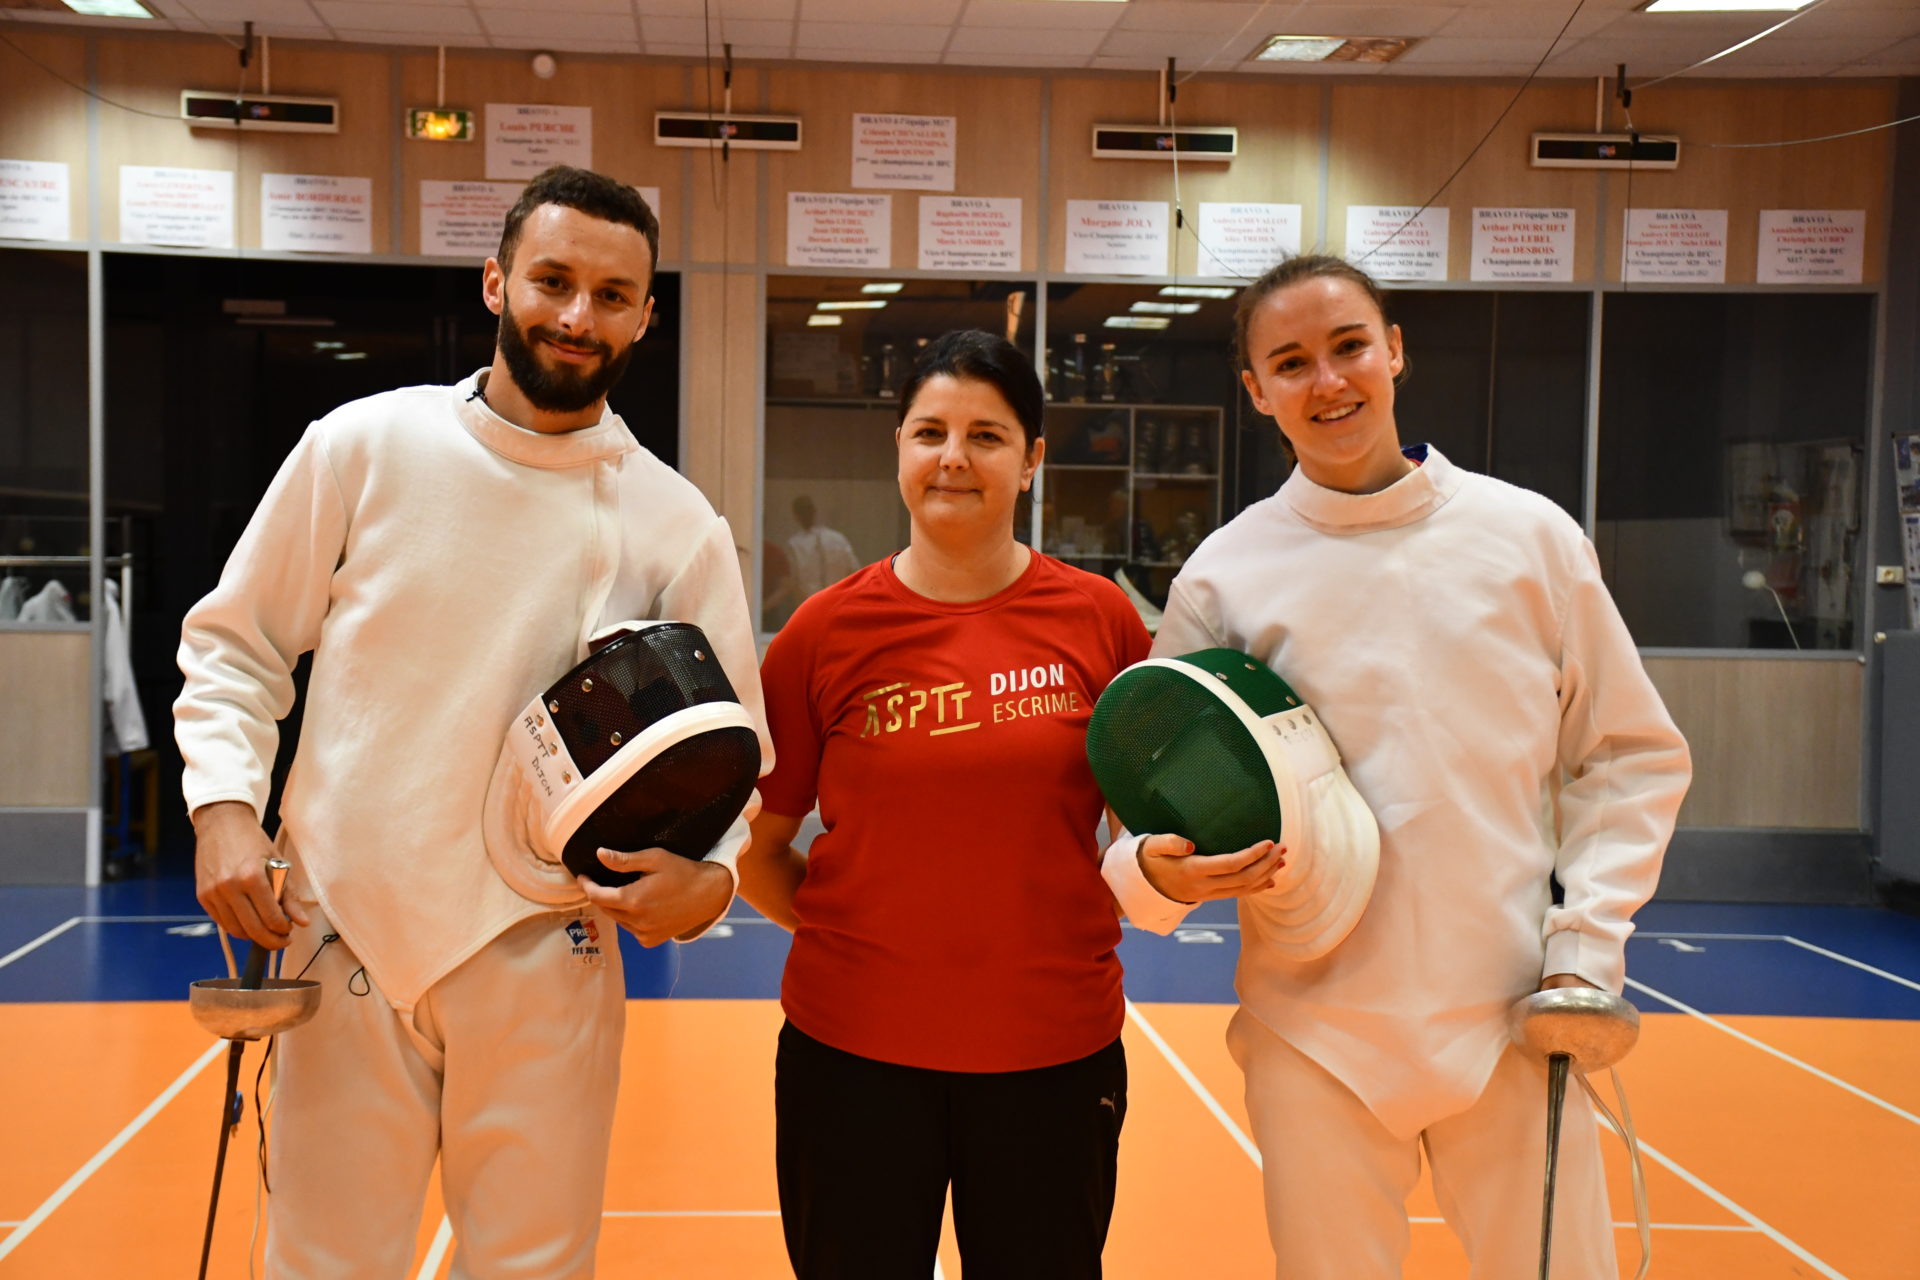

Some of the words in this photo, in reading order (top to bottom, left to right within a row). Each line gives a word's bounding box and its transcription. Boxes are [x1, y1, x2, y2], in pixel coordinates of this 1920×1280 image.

[951, 200, 983, 208] BRAVO
[1379, 209, 1411, 217] BRAVO
[1520, 211, 1549, 219] l'équipe
[1081, 217, 1122, 228] Morgane
[1126, 218, 1152, 227] JOLY
[1480, 223, 1509, 231] Arthur
[1493, 234, 1518, 242] Sacha
[1521, 235, 1552, 243] LEBEL
[990, 663, 1065, 696] DIJON
[860, 682, 979, 738] ASPTT
[993, 691, 1079, 724] ESCRIME
[524, 716, 551, 758] ASPTT
[532, 756, 553, 797] DIJON
